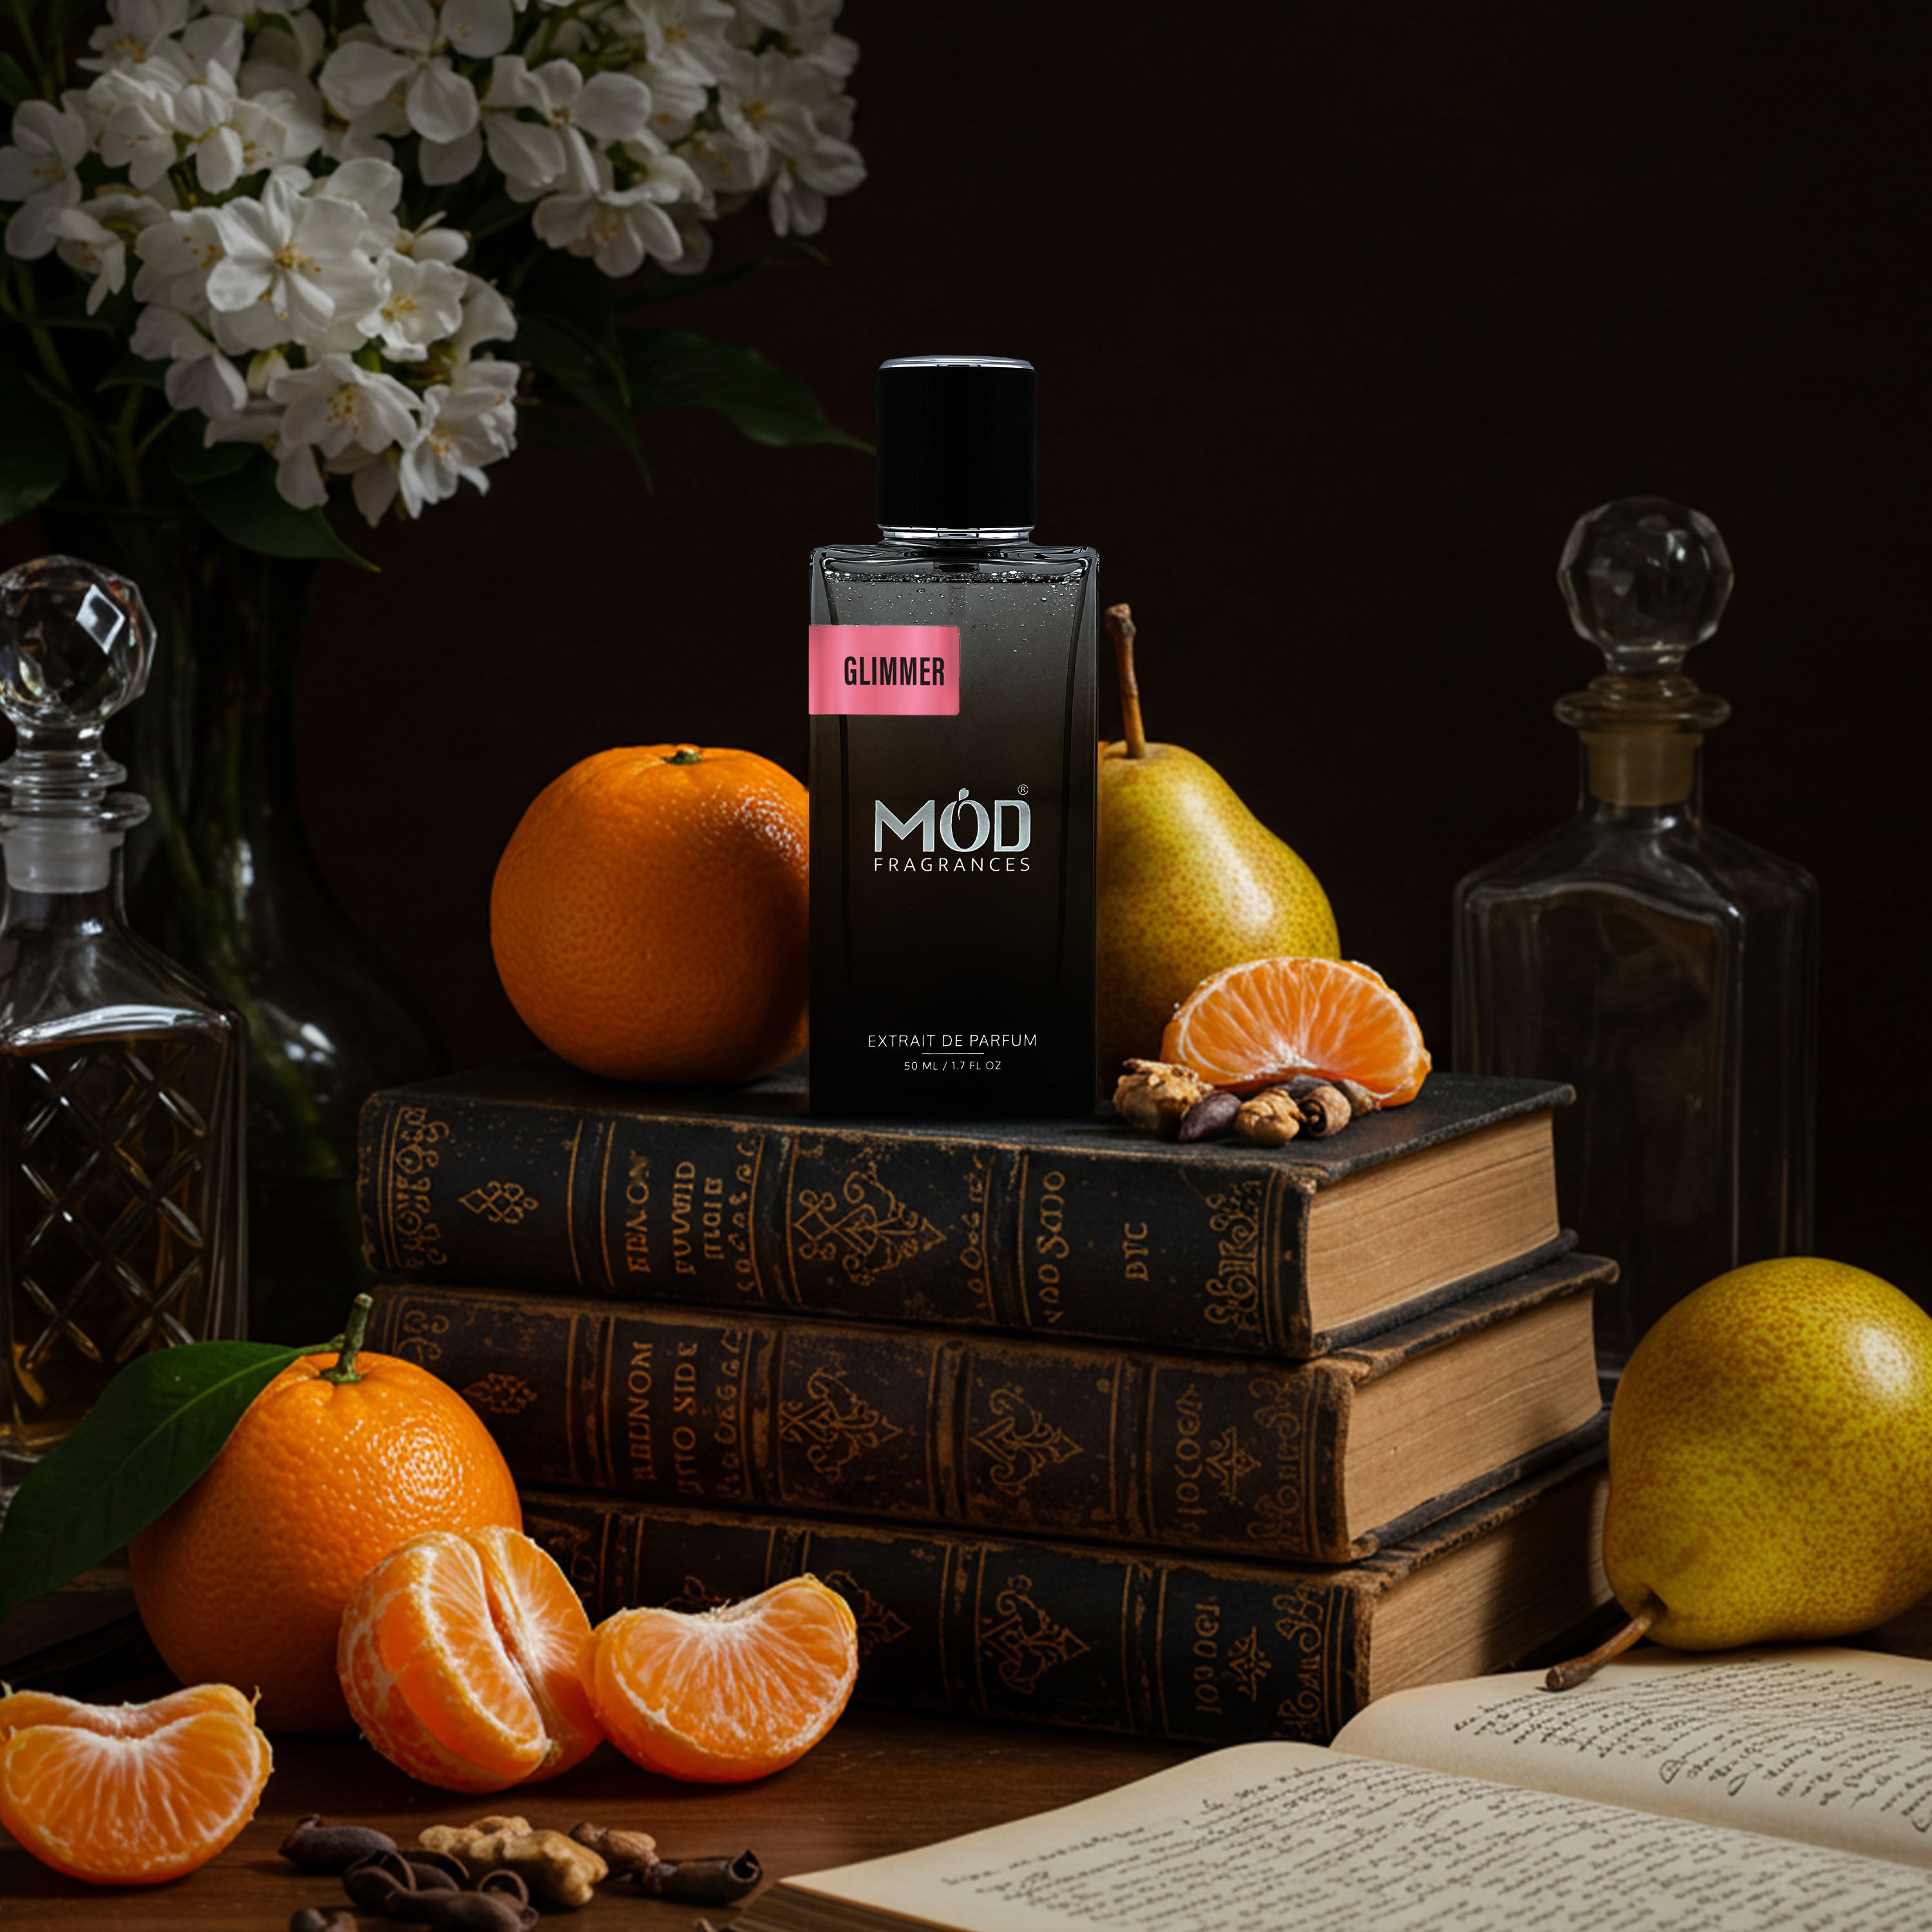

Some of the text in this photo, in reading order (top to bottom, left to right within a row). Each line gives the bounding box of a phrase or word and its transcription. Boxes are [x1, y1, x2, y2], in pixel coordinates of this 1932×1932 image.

[844, 656, 945, 686] GLIMMER
[874, 857, 1030, 872] FRAGRANCES
[868, 1034, 1037, 1047] EXTRAIT DE PARFUM
[904, 1061, 918, 1070] 50
[922, 1061, 938, 1070] ML
[952, 1061, 965, 1070] 1.7
[970, 1061, 981, 1070] FL
[985, 1061, 1001, 1070] OZ
